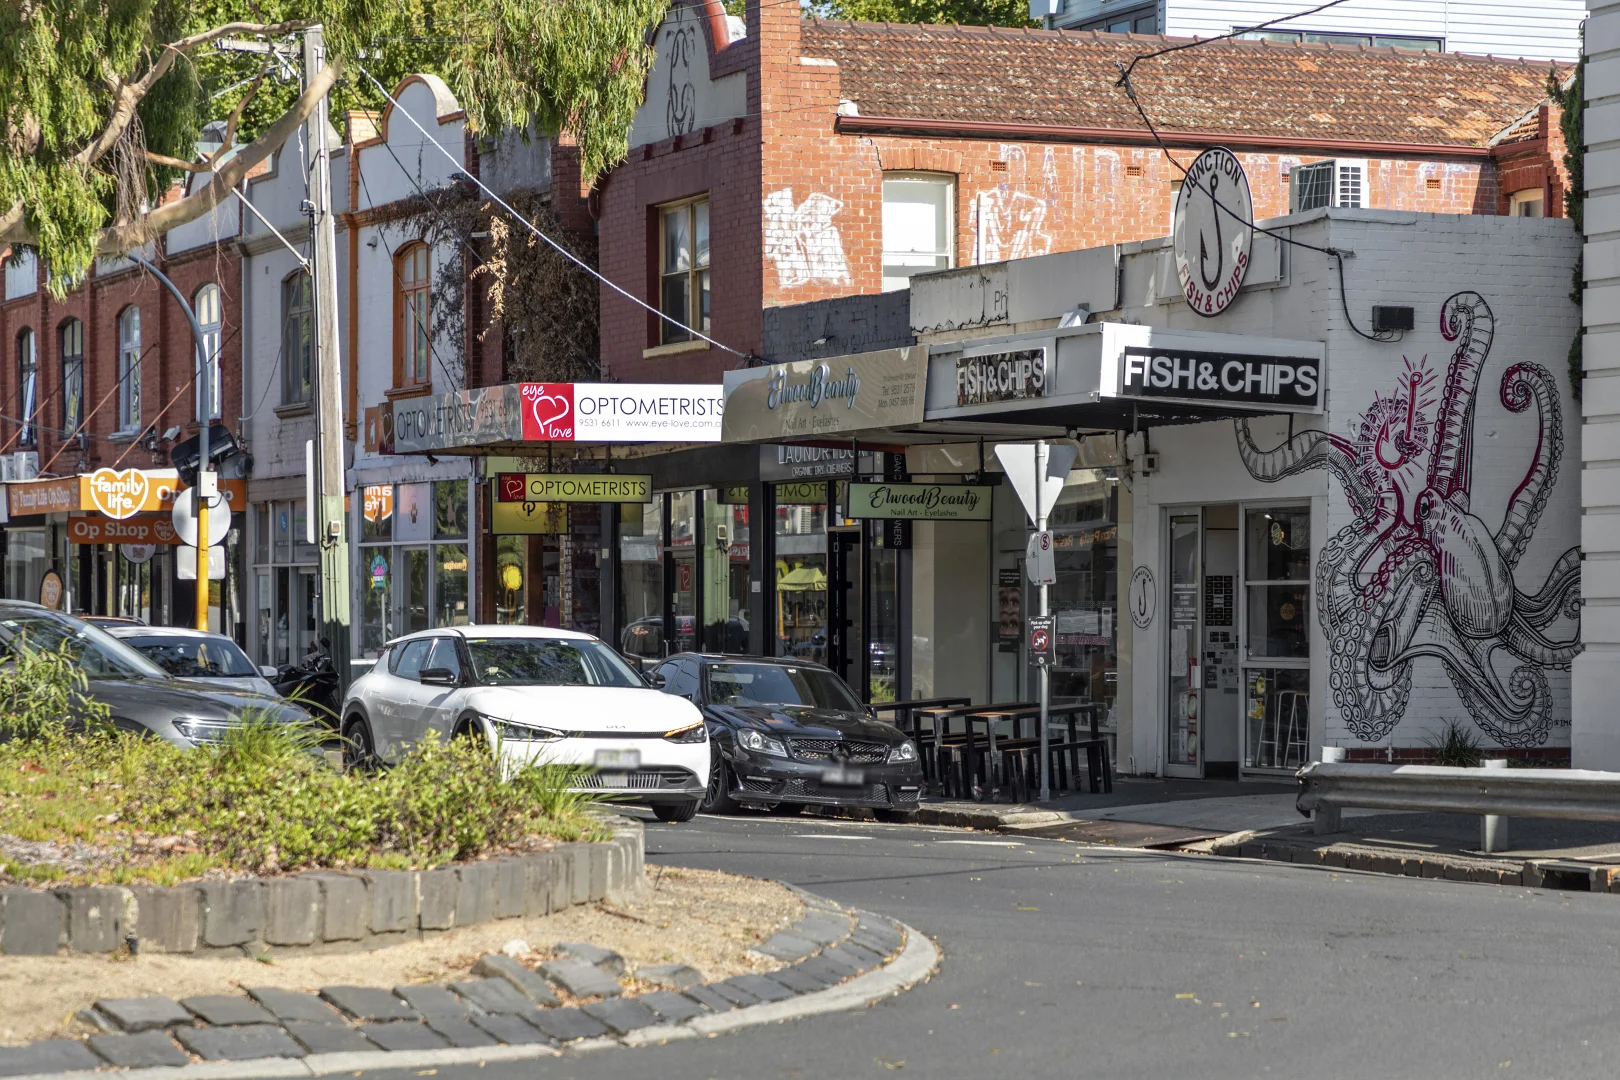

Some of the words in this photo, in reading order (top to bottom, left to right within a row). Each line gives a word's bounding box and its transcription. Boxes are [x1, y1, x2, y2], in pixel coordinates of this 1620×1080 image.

[1185, 152, 1242, 199] JUNCTION
[1177, 263, 1204, 310] FISH
[1204, 294, 1213, 313] &
[1216, 251, 1248, 310] CHIPS
[522, 384, 545, 400] eye
[579, 396, 723, 416] OPTOMETRISTS
[549, 423, 573, 438] love
[579, 419, 598, 428] 9531
[600, 419, 621, 428] 6611
[792, 465, 813, 477] ORGANIC
[814, 464, 825, 475] DRY
[827, 462, 853, 475] CLEANERS
[97, 476, 144, 496] family
[530, 480, 646, 496] OPTOMETRISTS
[48, 487, 57, 507] Op
[57, 486, 70, 507] Shop
[890, 508, 905, 516] Nail
[907, 508, 918, 516] Art
[924, 508, 958, 518] Eyelashes
[74, 521, 100, 539] Op
[104, 521, 149, 539] Shop
